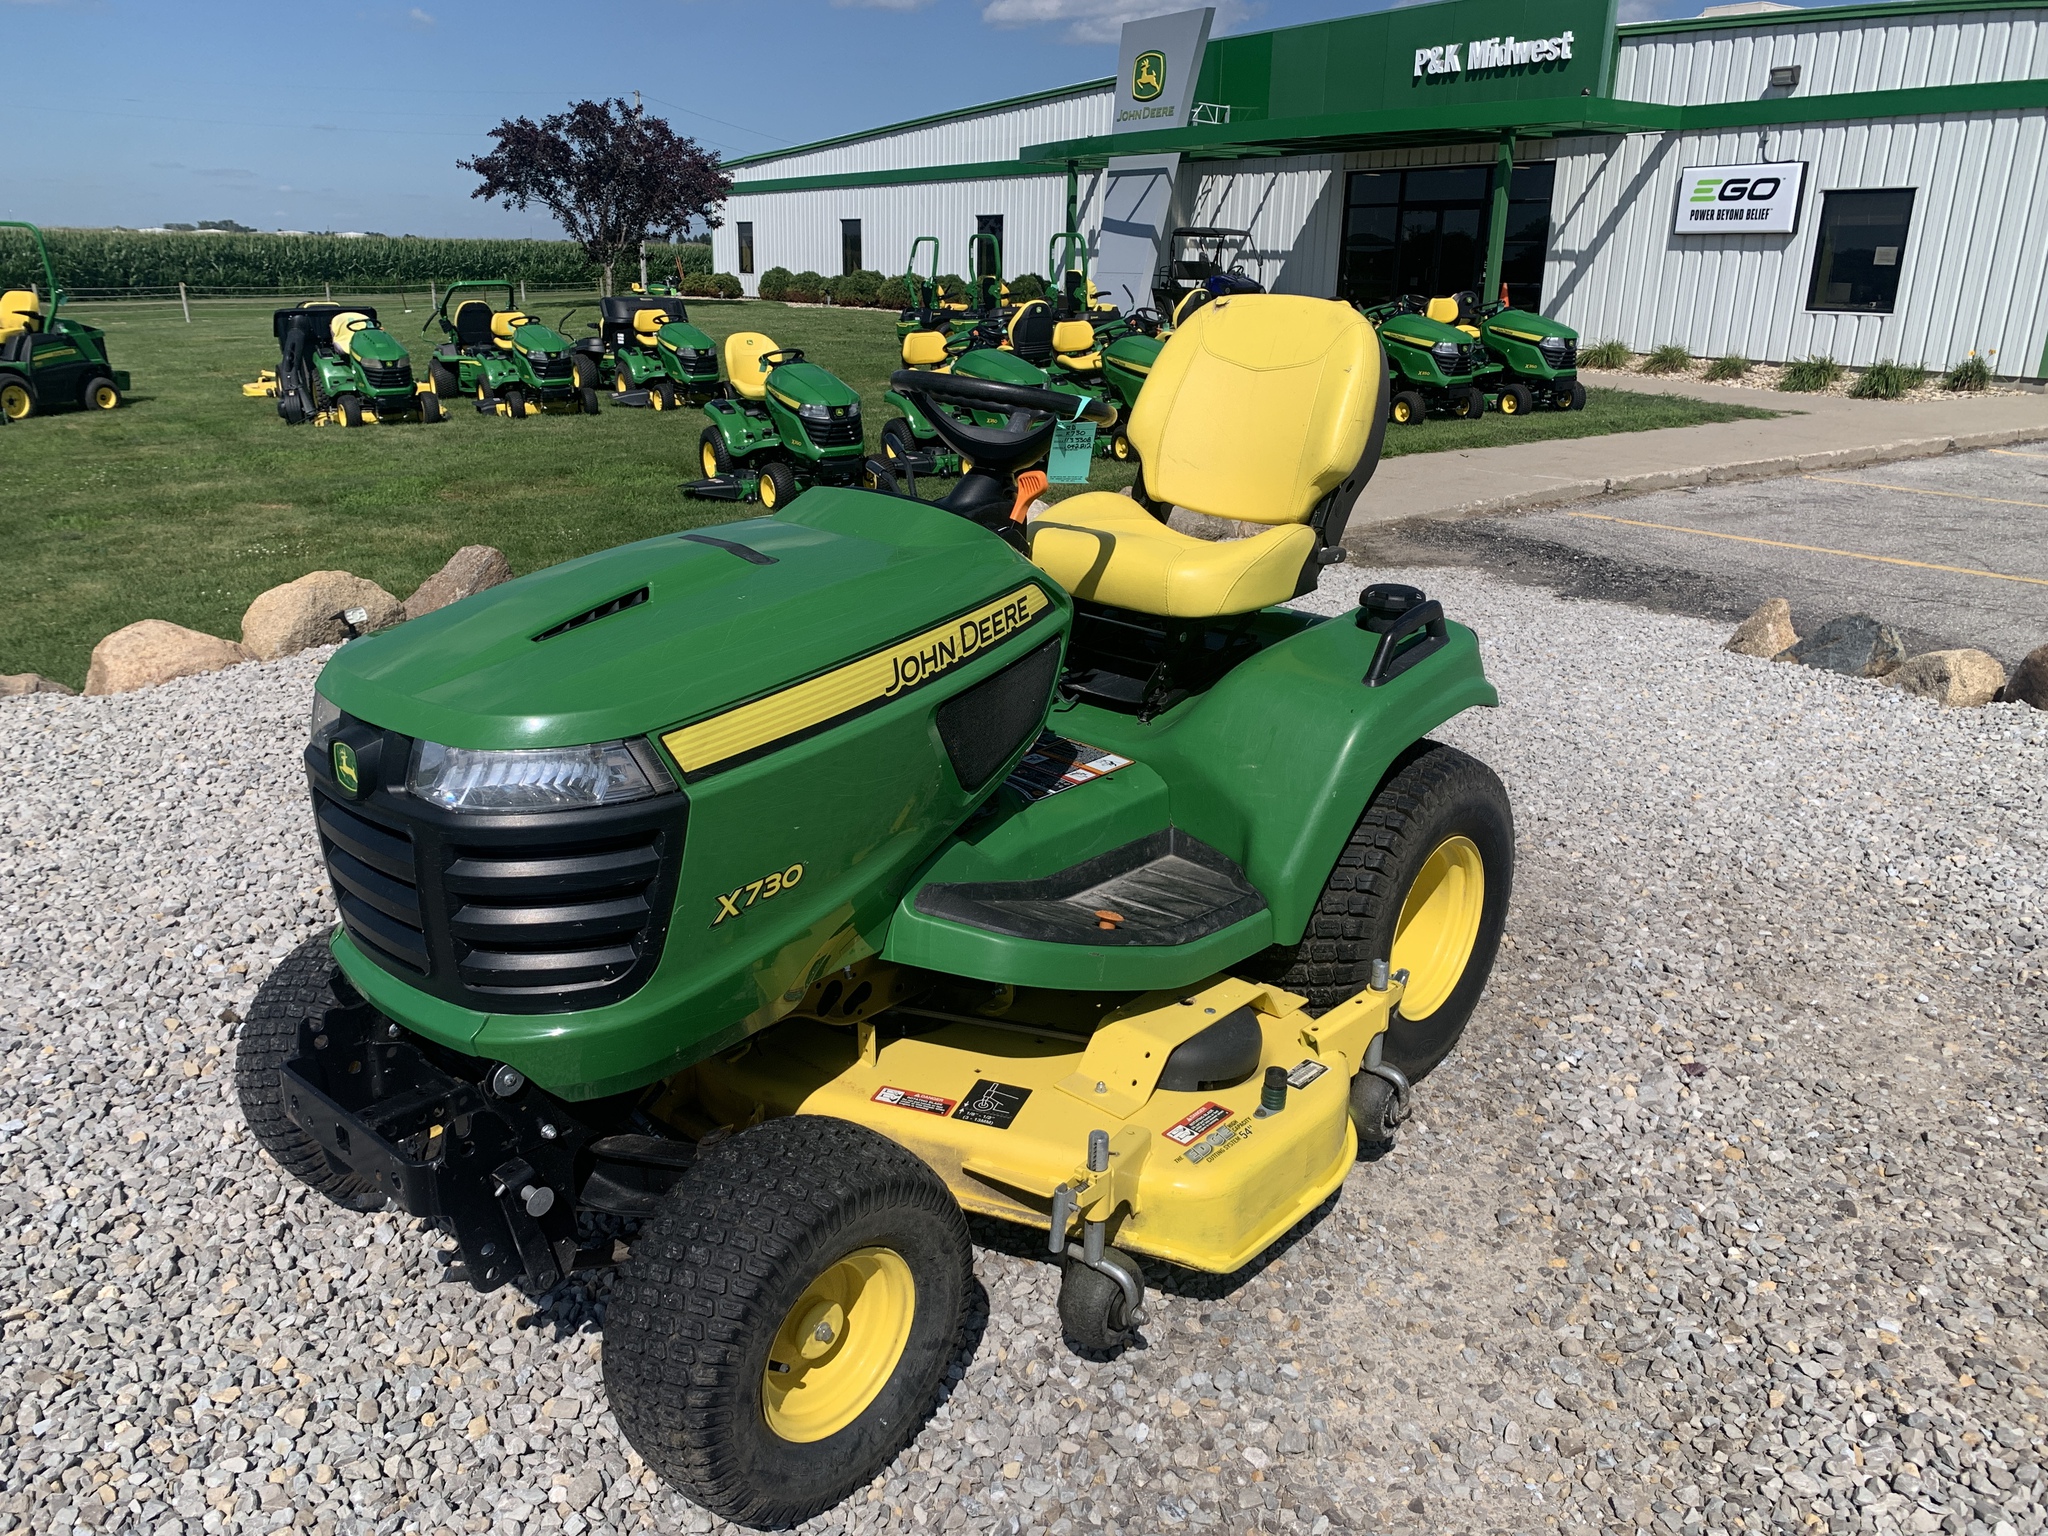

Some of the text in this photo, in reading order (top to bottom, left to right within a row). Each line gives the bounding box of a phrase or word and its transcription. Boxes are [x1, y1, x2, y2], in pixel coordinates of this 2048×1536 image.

[1413, 30, 1575, 77] P&K Midwest
[1116, 106, 1175, 122] JOHN DEERE
[1689, 177, 1781, 202] EGO
[1689, 208, 1771, 221] POWER BEYOND BELIEF
[885, 595, 1030, 694] JOHN DEERE
[710, 862, 805, 927] X730
[920, 1093, 945, 1103] DANGER
[1231, 1116, 1252, 1132] CAPACITY
[1174, 1124, 1236, 1165] THE EDGE
[1206, 1147, 1226, 1163] CUTTING
[1225, 1136, 1242, 1151] SYSTEM
